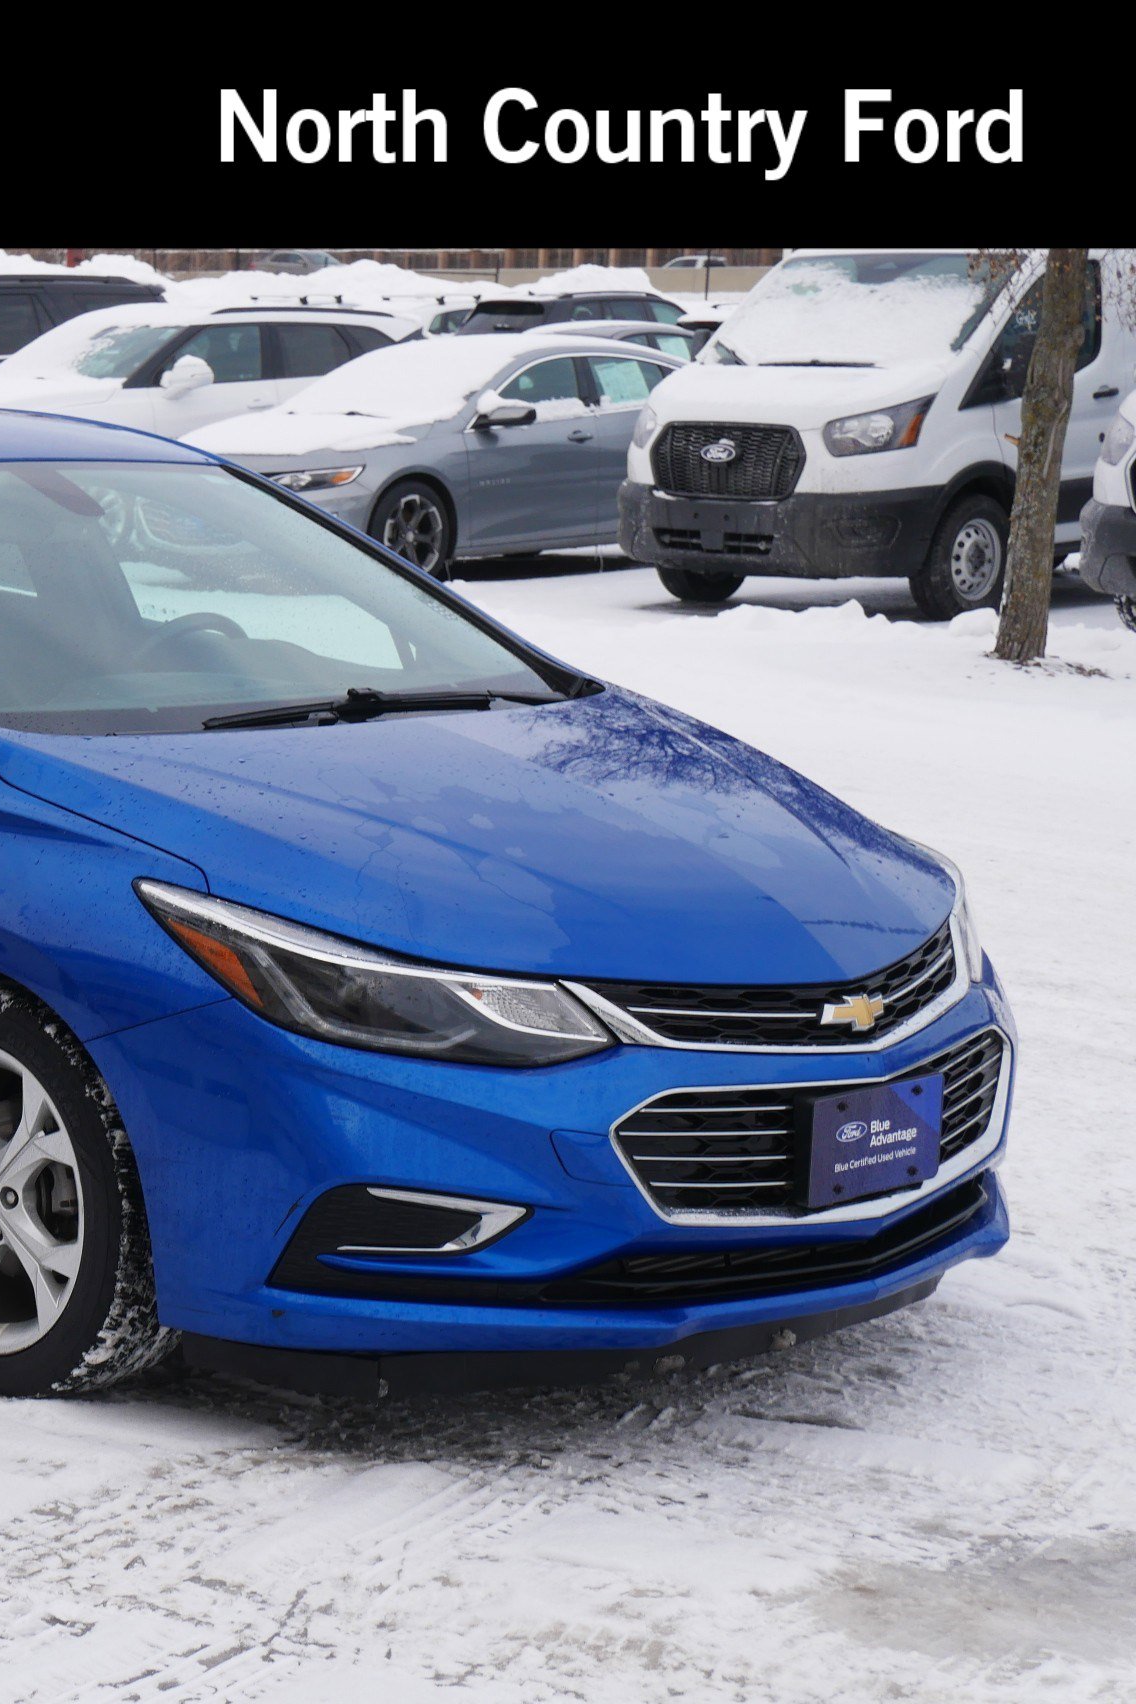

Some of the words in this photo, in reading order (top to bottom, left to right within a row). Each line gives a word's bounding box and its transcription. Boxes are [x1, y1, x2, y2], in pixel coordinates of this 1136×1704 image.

[840, 1124, 863, 1140] Ford
[870, 1119, 890, 1133] Blue
[869, 1127, 917, 1148] Advantage
[834, 1162, 848, 1173] Blue
[849, 1155, 876, 1169] Certified
[877, 1150, 894, 1163] Used
[894, 1146, 916, 1158] Vehicle
